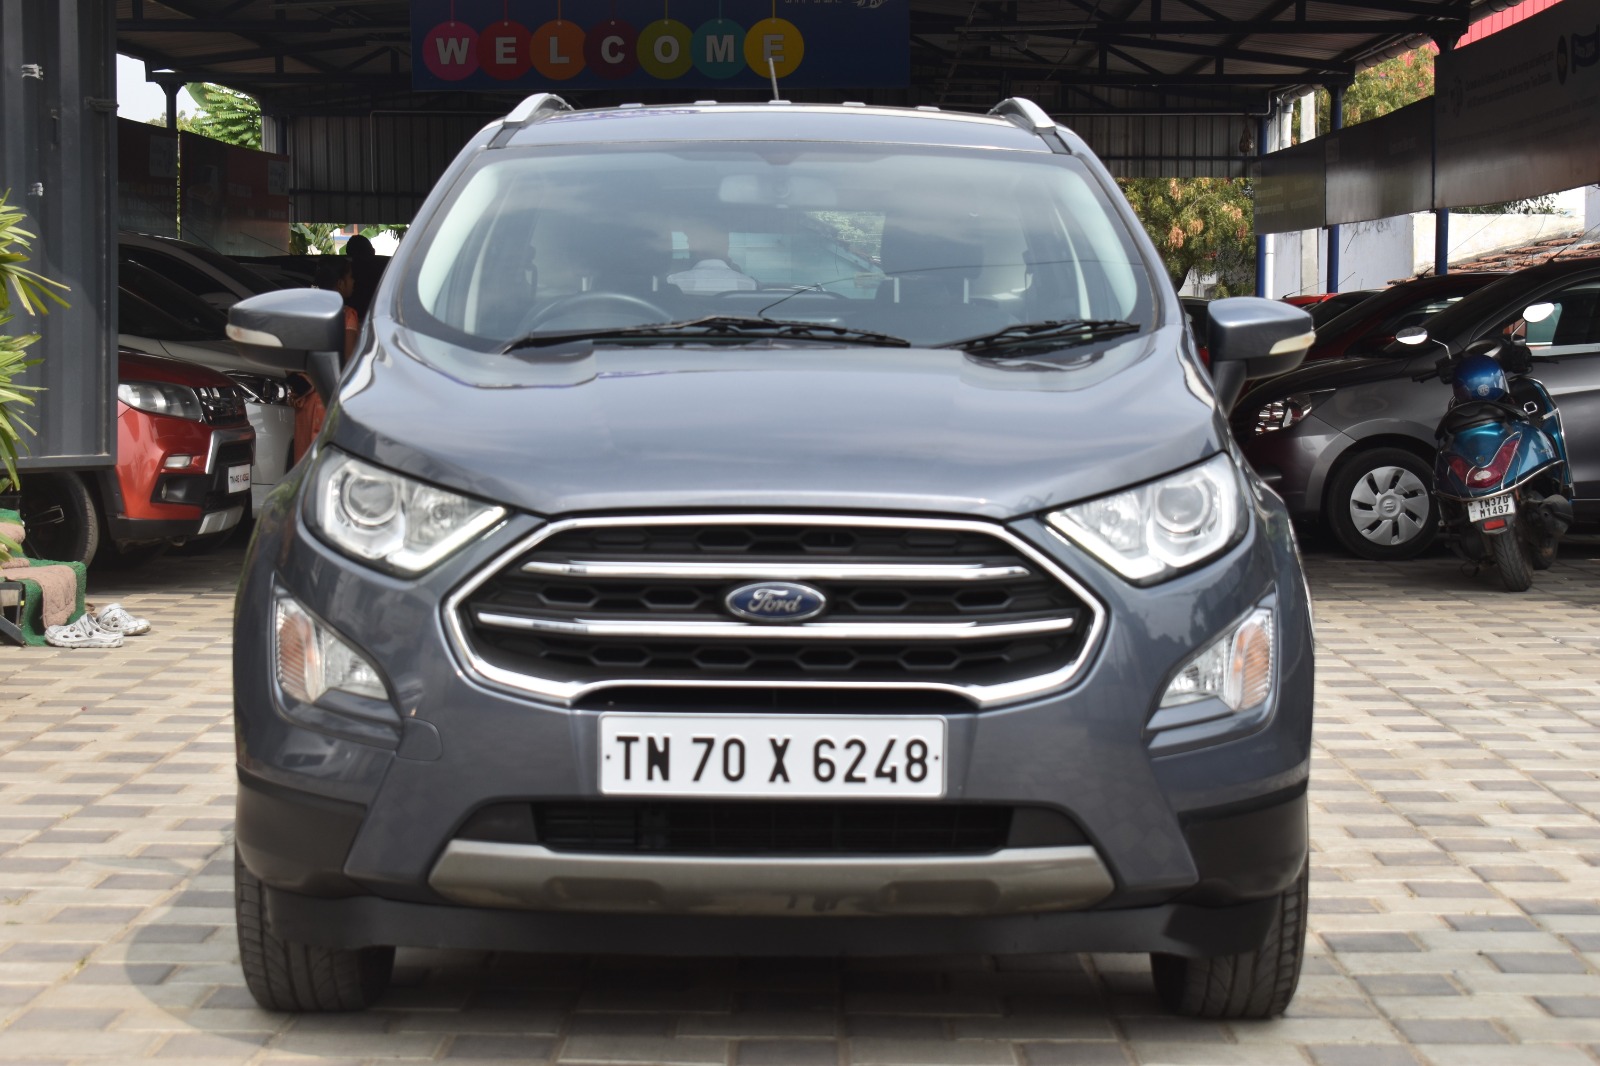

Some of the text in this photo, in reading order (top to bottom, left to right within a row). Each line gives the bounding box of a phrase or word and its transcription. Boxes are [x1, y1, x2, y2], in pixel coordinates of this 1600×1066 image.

[435, 34, 785, 66] WELCOME
[747, 588, 803, 613] Ford
[616, 736, 928, 783] TN 70 X 6248
